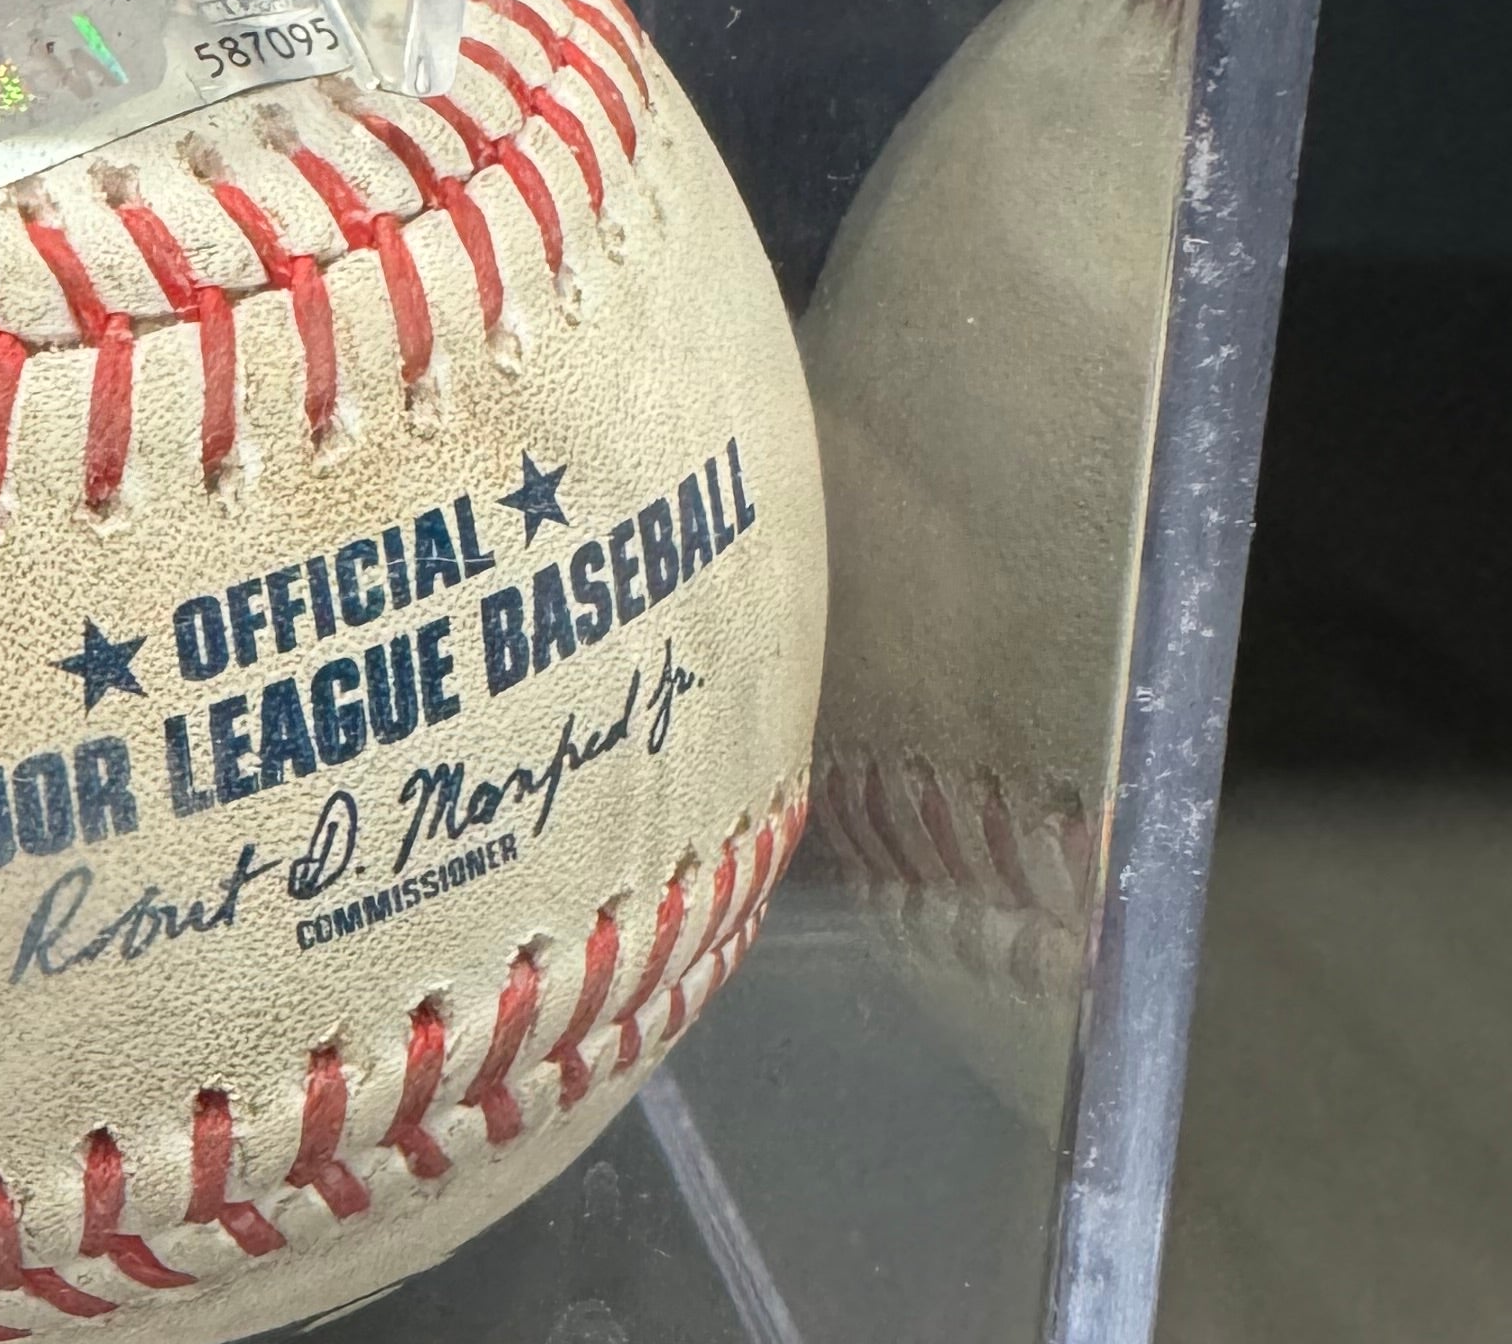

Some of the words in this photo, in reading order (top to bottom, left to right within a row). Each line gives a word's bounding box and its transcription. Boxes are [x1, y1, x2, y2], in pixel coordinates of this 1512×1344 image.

[193, 17, 340, 79] 587095
[164, 615, 462, 818] LEAGUE
[480, 436, 757, 698] BASEBALL
[173, 494, 496, 682] OFFICIAL
[295, 832, 519, 953] COMMISSIONER
